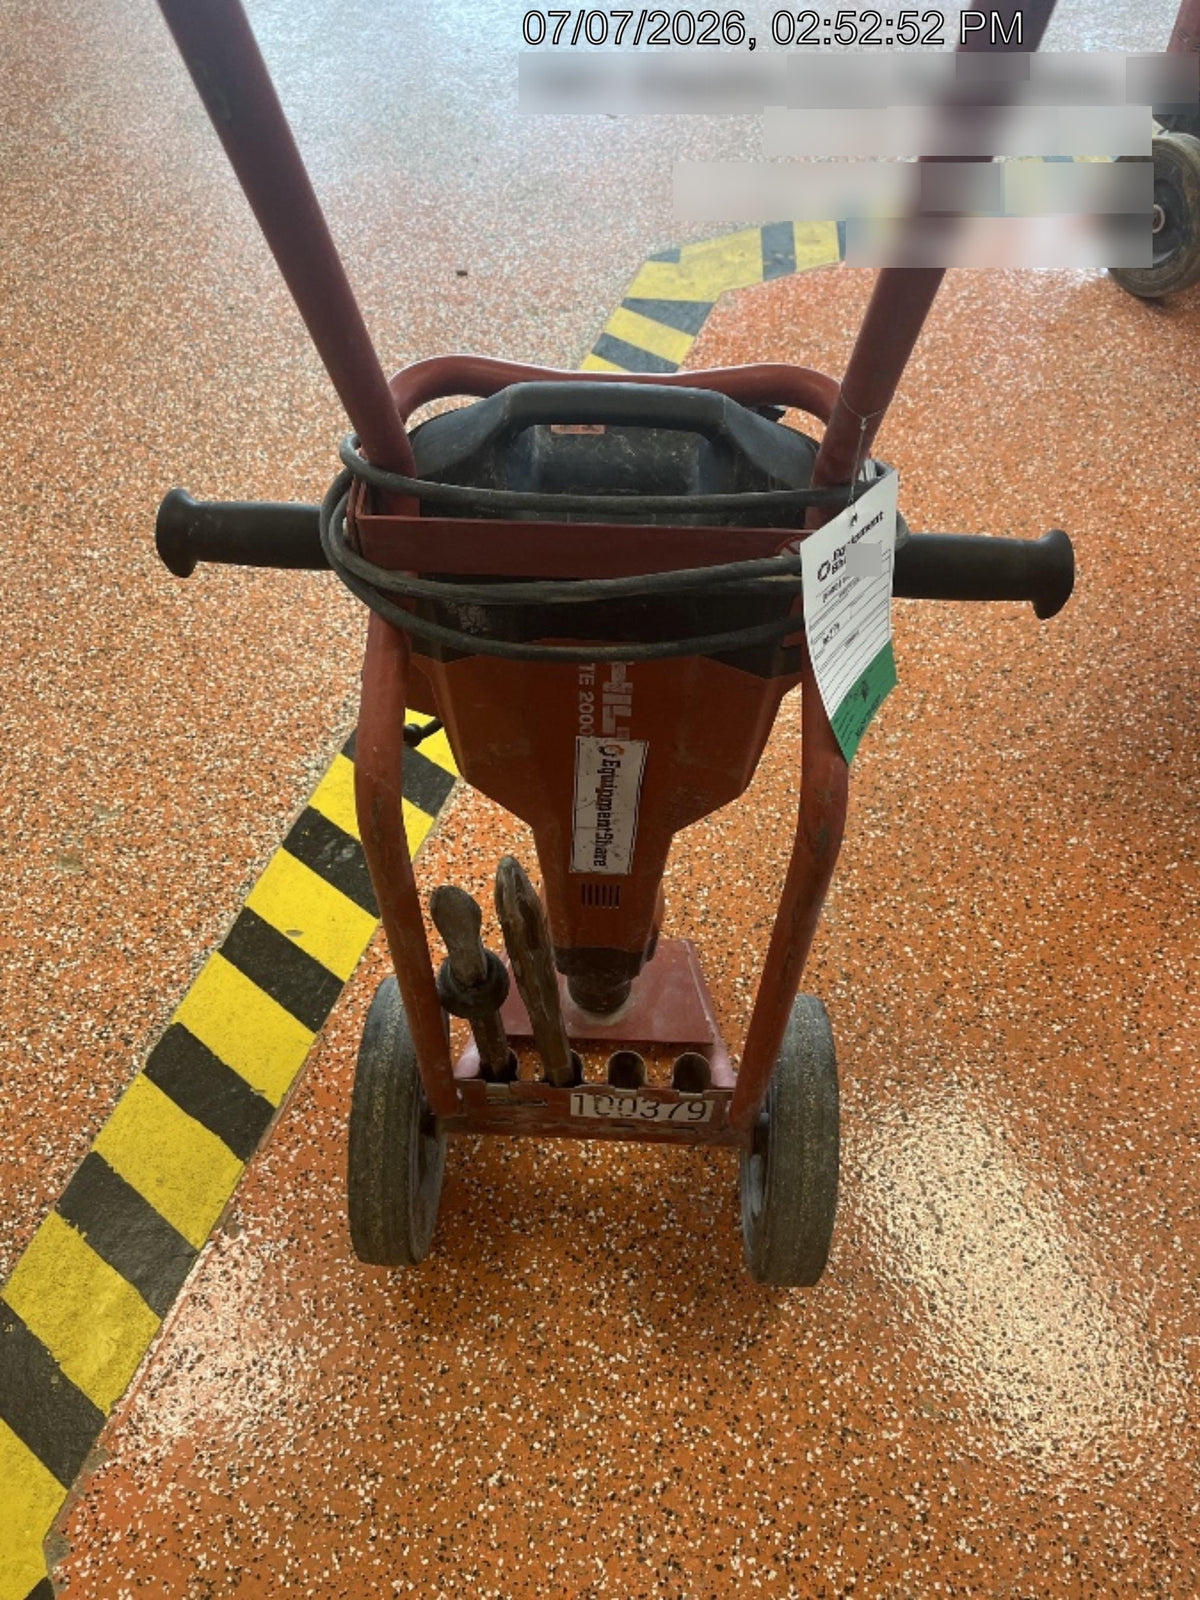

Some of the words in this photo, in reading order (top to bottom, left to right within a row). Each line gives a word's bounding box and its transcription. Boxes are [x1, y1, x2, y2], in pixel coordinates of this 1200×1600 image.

[577, 662, 596, 686] TE
[593, 758, 622, 867] EquipmentShare
[573, 1094, 707, 1121] 100379
